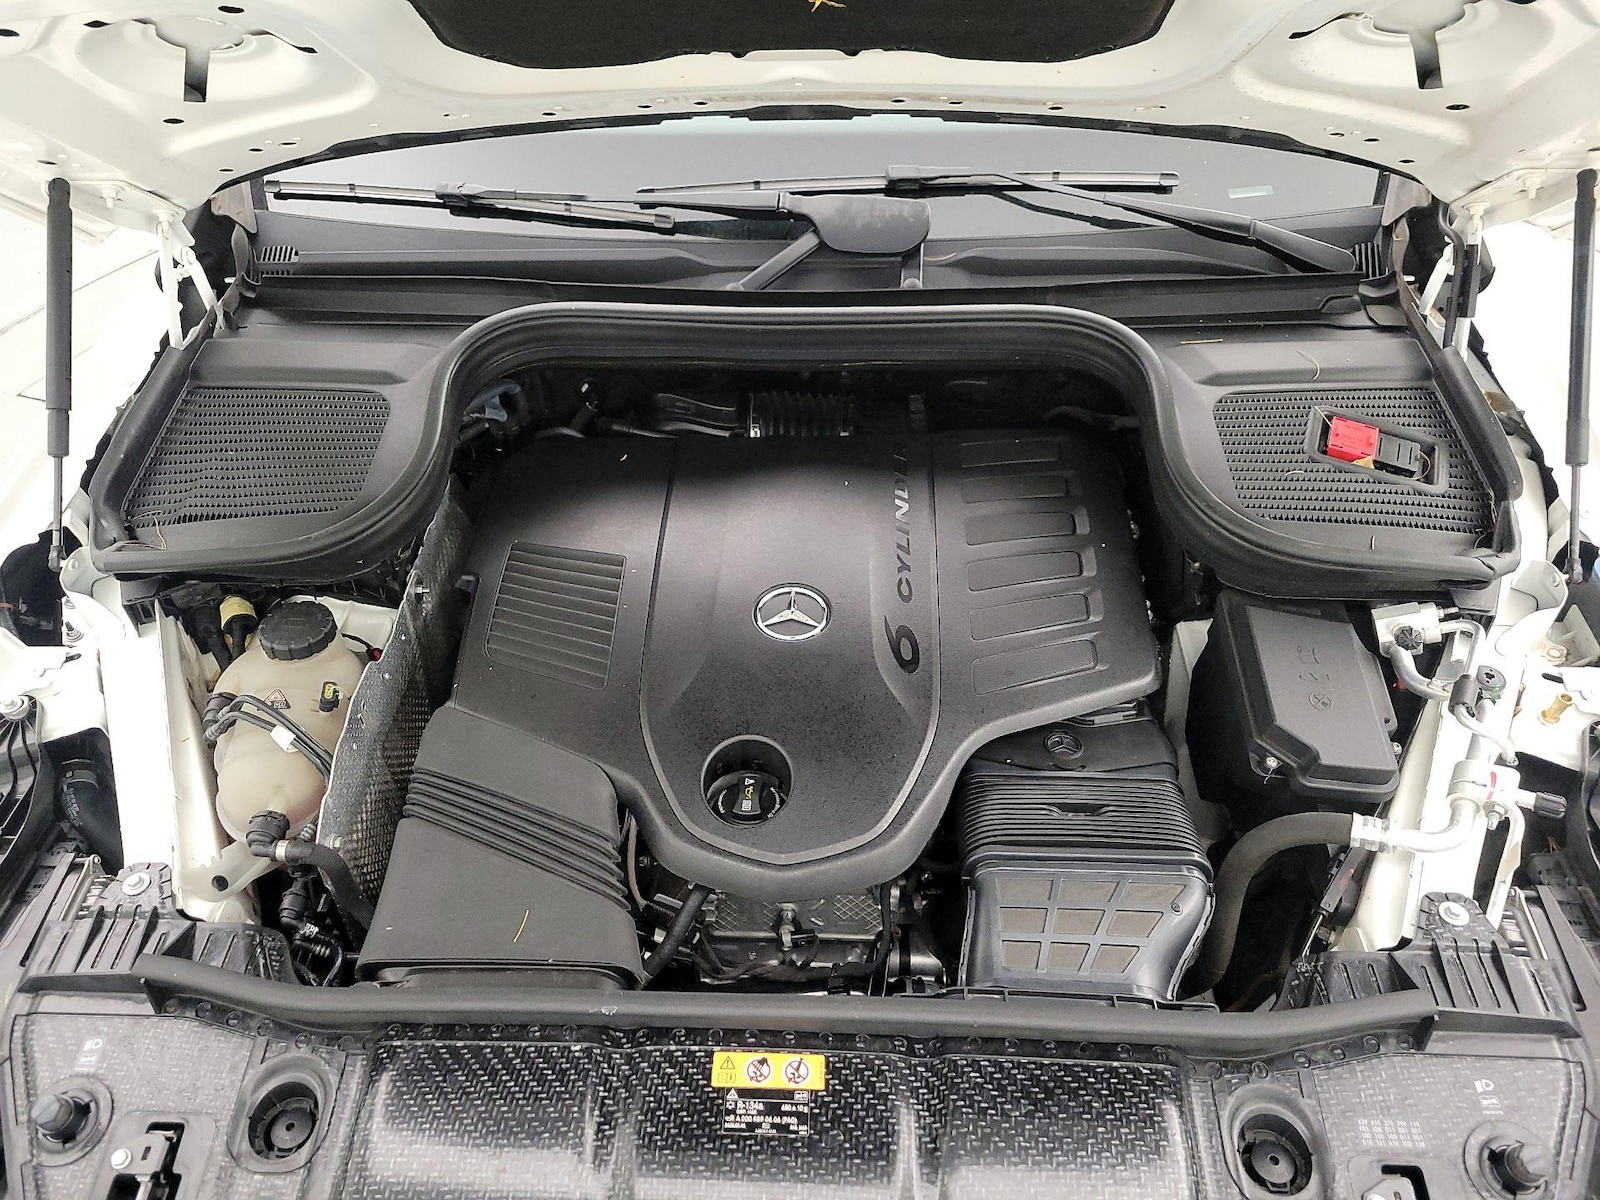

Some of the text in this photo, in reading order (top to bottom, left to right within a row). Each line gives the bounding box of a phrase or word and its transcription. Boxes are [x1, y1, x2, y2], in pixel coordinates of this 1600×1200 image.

[884, 445, 920, 674] 6 CYLIND
[737, 1101, 764, 1110] R-134a
